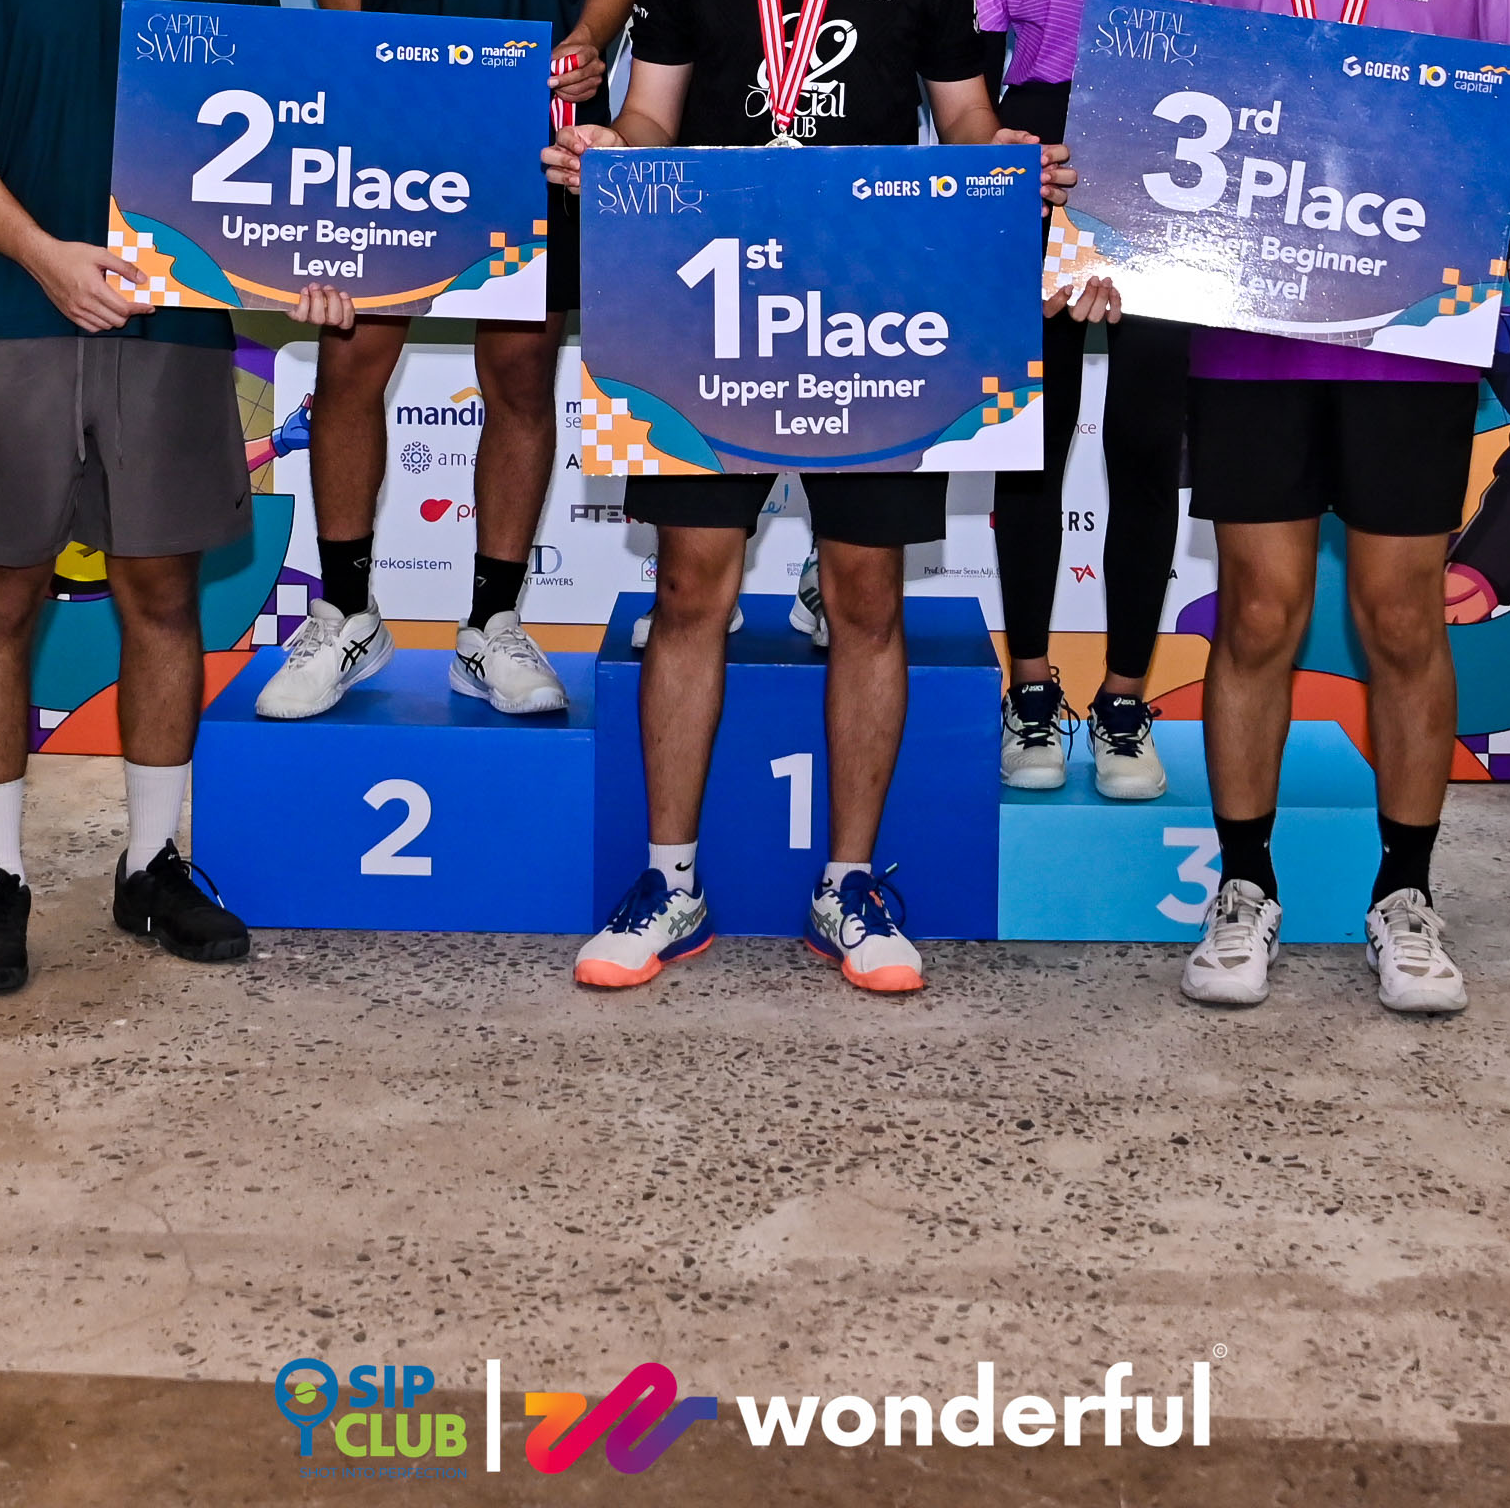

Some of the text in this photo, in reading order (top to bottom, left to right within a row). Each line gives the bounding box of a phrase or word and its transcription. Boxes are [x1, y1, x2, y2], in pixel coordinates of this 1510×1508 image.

[147, 13, 228, 36] CAPITAL
[1109, 6, 1191, 36] CAPITAL
[396, 44, 474, 65] GOERS 10
[481, 45, 526, 58] mandiri
[481, 57, 517, 69] capital
[1364, 61, 1447, 87] GOERS 10
[1453, 80, 1492, 94] capital
[192, 90, 326, 205] 2nd
[1142, 91, 1280, 211] 3rd
[290, 146, 470, 213] Place
[608, 161, 698, 183] CAPITAL
[965, 173, 1014, 186] mandiri
[875, 175, 958, 198] GOERS 10
[965, 186, 1005, 199] capital
[1237, 156, 1426, 244] Place
[222, 215, 437, 251] Upper Beginner
[293, 250, 364, 279] Level
[1261, 235, 1387, 277] Beginner
[677, 238, 783, 359] 1st
[757, 290, 949, 359] Place
[699, 373, 926, 406] Upper Beginner
[396, 401, 484, 427] mandi
[775, 408, 849, 435] Level
[374, 556, 452, 571] rekosistem
[536, 577, 574, 587] LAWYERS
[770, 754, 813, 849] 1
[361, 780, 432, 876] 2
[1161, 827, 1221, 923] 3
